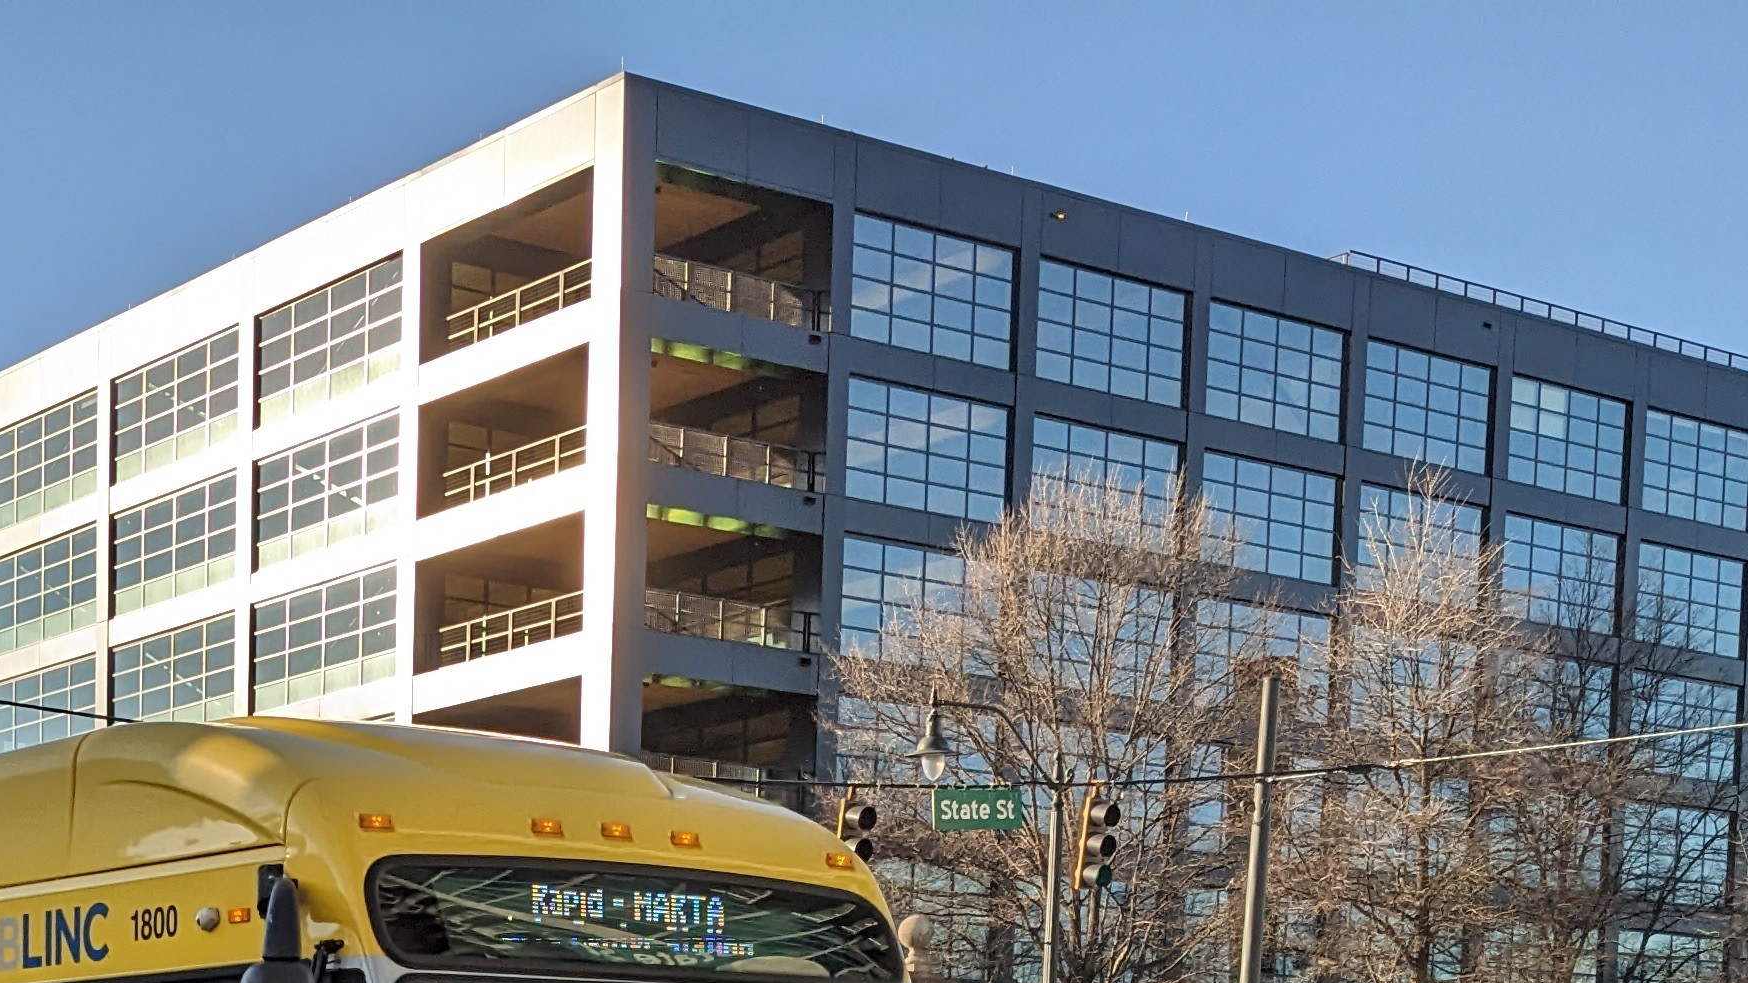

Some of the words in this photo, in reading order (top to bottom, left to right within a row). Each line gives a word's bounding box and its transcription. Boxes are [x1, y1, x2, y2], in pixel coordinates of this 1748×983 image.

[940, 799, 991, 820] State
[996, 799, 1015, 820] St
[131, 904, 178, 941] 1800
[633, 891, 725, 934] MARTA
